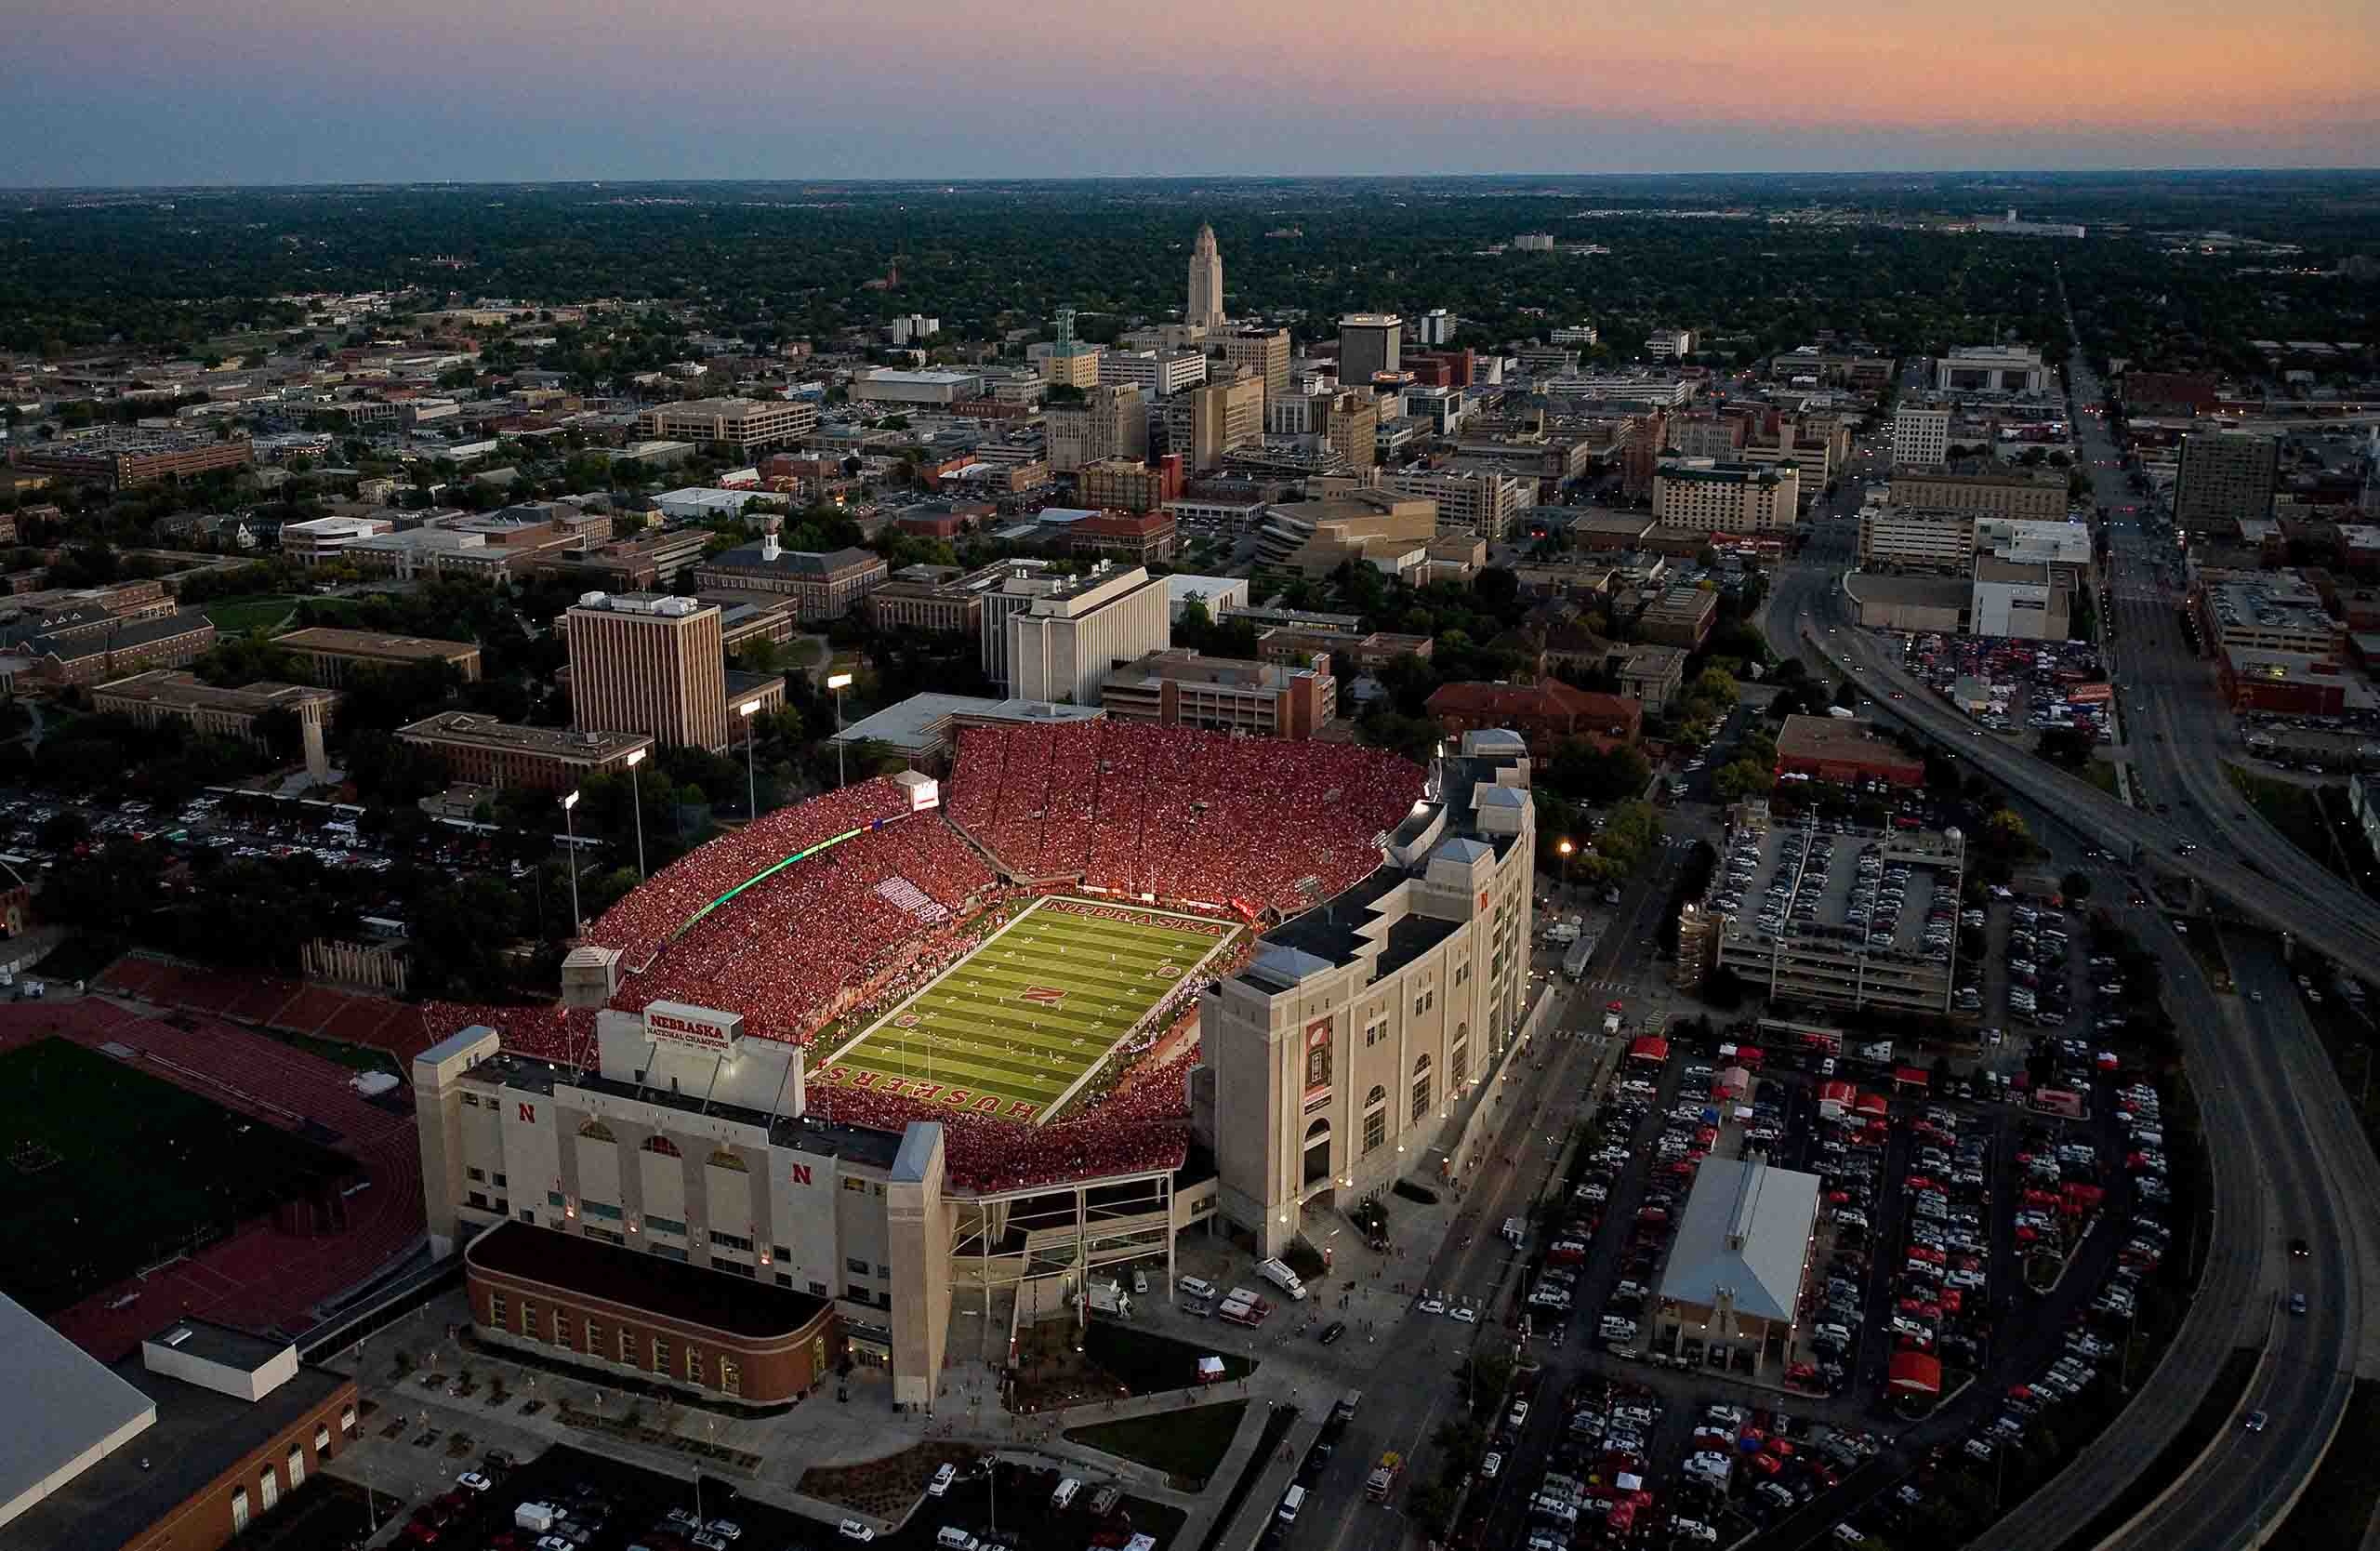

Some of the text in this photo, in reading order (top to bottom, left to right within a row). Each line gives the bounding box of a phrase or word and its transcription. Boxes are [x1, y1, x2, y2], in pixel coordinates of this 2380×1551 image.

[1480, 892, 1488, 911] N
[1041, 900, 1223, 937] NEBRASKA
[647, 1027, 684, 1041] NATIONAL
[685, 1035, 730, 1050] CHAMPIONS
[650, 1014, 724, 1040] NEBRASKA
[823, 1066, 1042, 1118] HUSKERS
[518, 1102, 536, 1124] N
[792, 1161, 812, 1186] N
